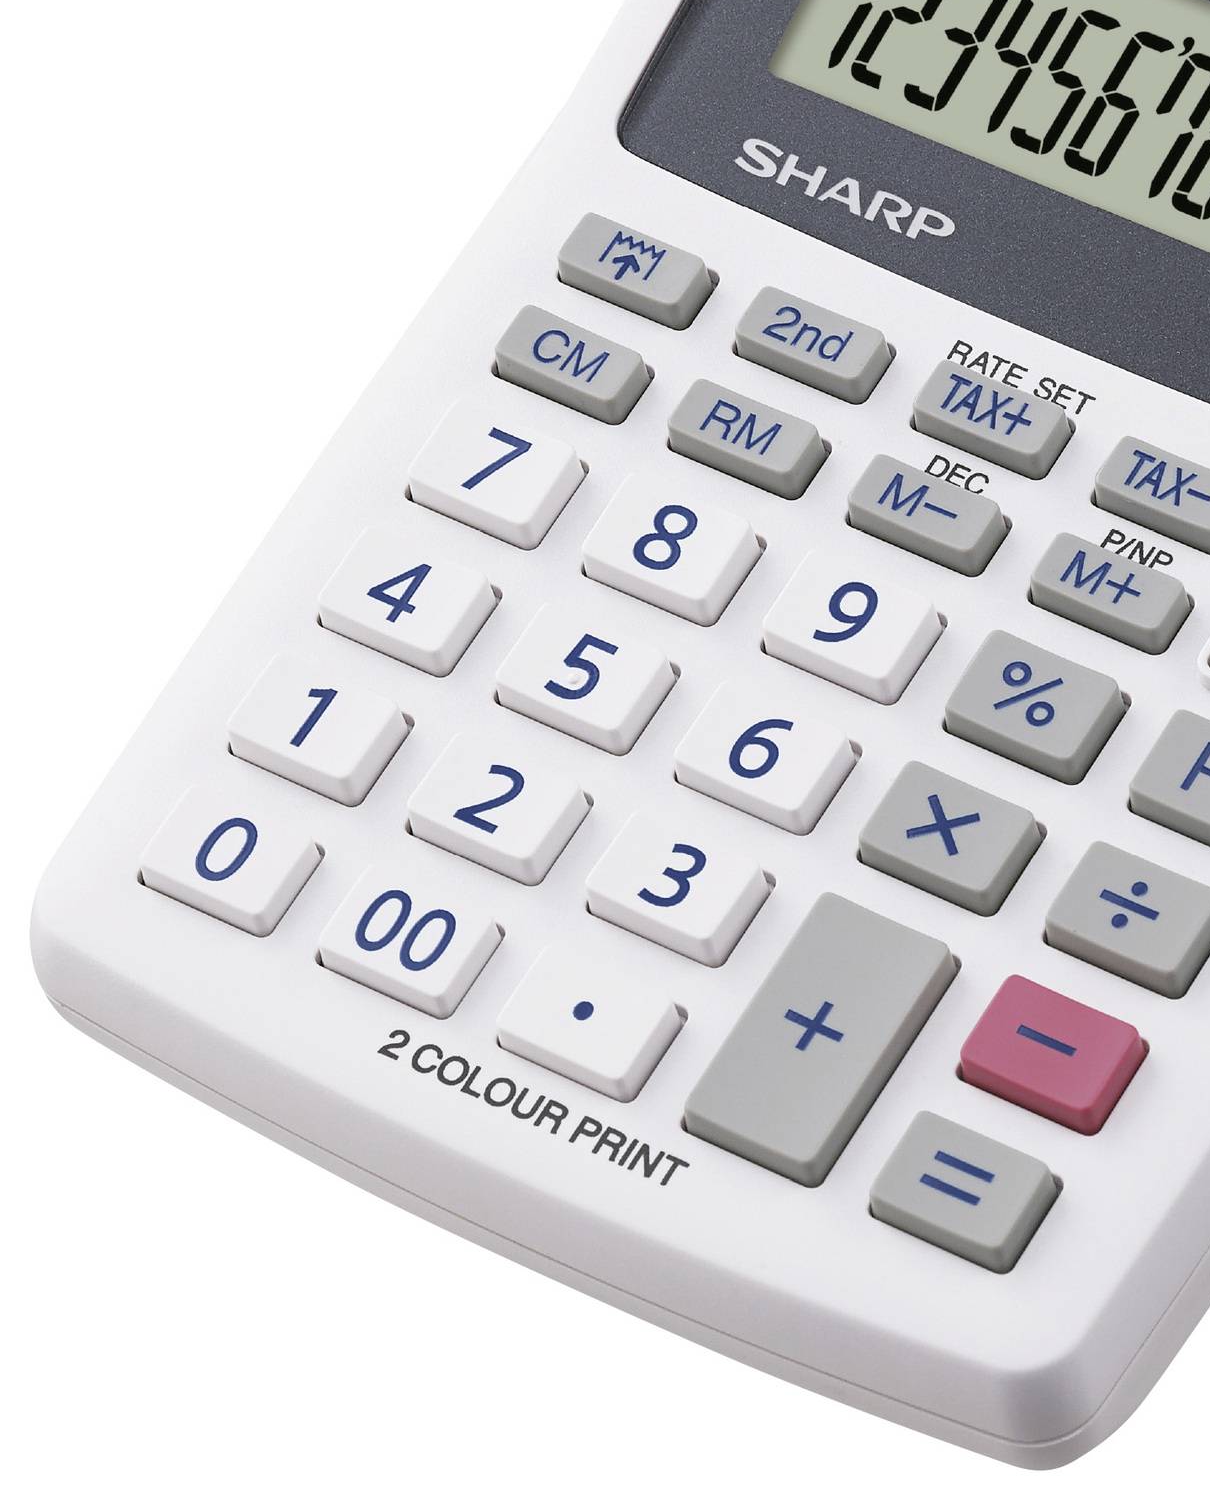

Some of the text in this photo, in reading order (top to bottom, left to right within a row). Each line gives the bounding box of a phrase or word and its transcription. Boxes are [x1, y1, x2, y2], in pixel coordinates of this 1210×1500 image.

[734, 137, 956, 245] SHARP
[532, 329, 610, 384] CM
[762, 306, 855, 363] 2nd
[940, 373, 1032, 436] TAX+
[947, 339, 1096, 415] RATE SET
[461, 426, 533, 491] 7
[700, 400, 783, 456] RM
[924, 454, 990, 494] DEC
[632, 504, 698, 571] 8
[1100, 528, 1174, 569] P/NP
[366, 563, 432, 623] 4
[1060, 549, 1141, 604] M+
[812, 581, 879, 643] 9
[543, 633, 619, 700] 5
[993, 660, 1064, 728] %
[289, 688, 338, 748] 1
[727, 718, 794, 780] 6
[452, 764, 525, 834] 2
[195, 817, 258, 882] 0
[637, 843, 707, 908] 3
[354, 889, 456, 972] 00
[783, 1001, 844, 1052] +
[377, 1028, 690, 1187] 2 COLOUR PRINT
[919, 1150, 995, 1207] =
